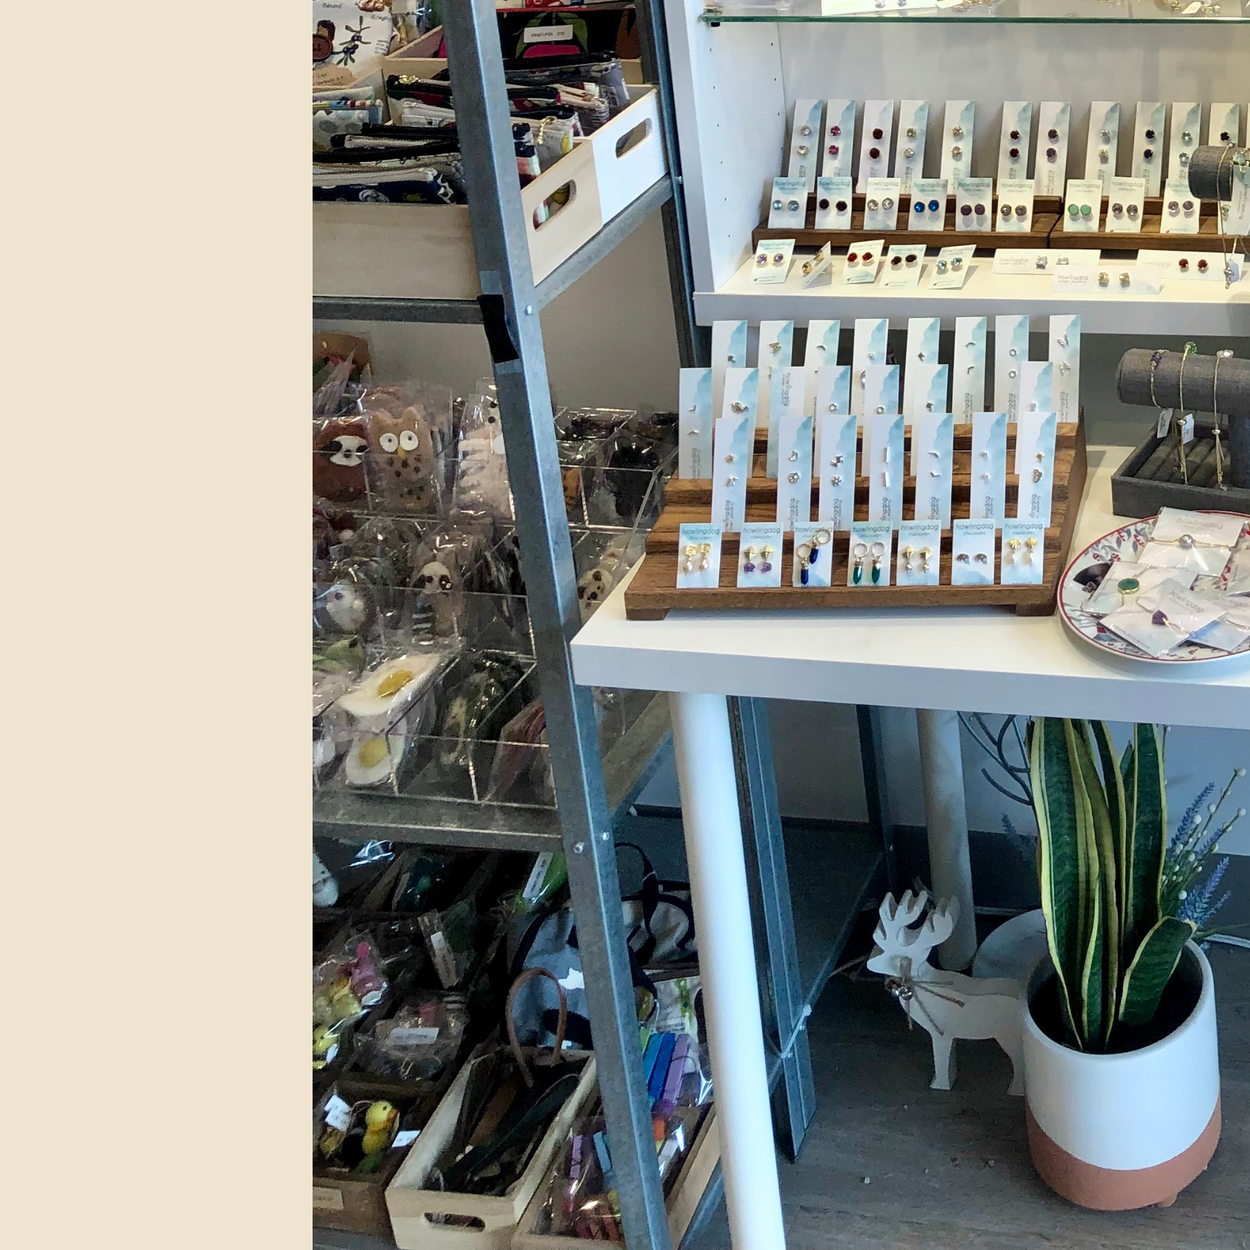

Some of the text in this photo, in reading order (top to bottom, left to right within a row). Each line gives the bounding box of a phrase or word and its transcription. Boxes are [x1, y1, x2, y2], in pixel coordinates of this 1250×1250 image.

[743, 526, 781, 535] howlingdog
[795, 525, 833, 534] howlingdog
[853, 525, 890, 535] howlingdog
[901, 524, 939, 533] howlingdog
[956, 522, 994, 532] howlingdog
[1005, 522, 1043, 531] howlingdog
[682, 527, 720, 536] howlingdog
